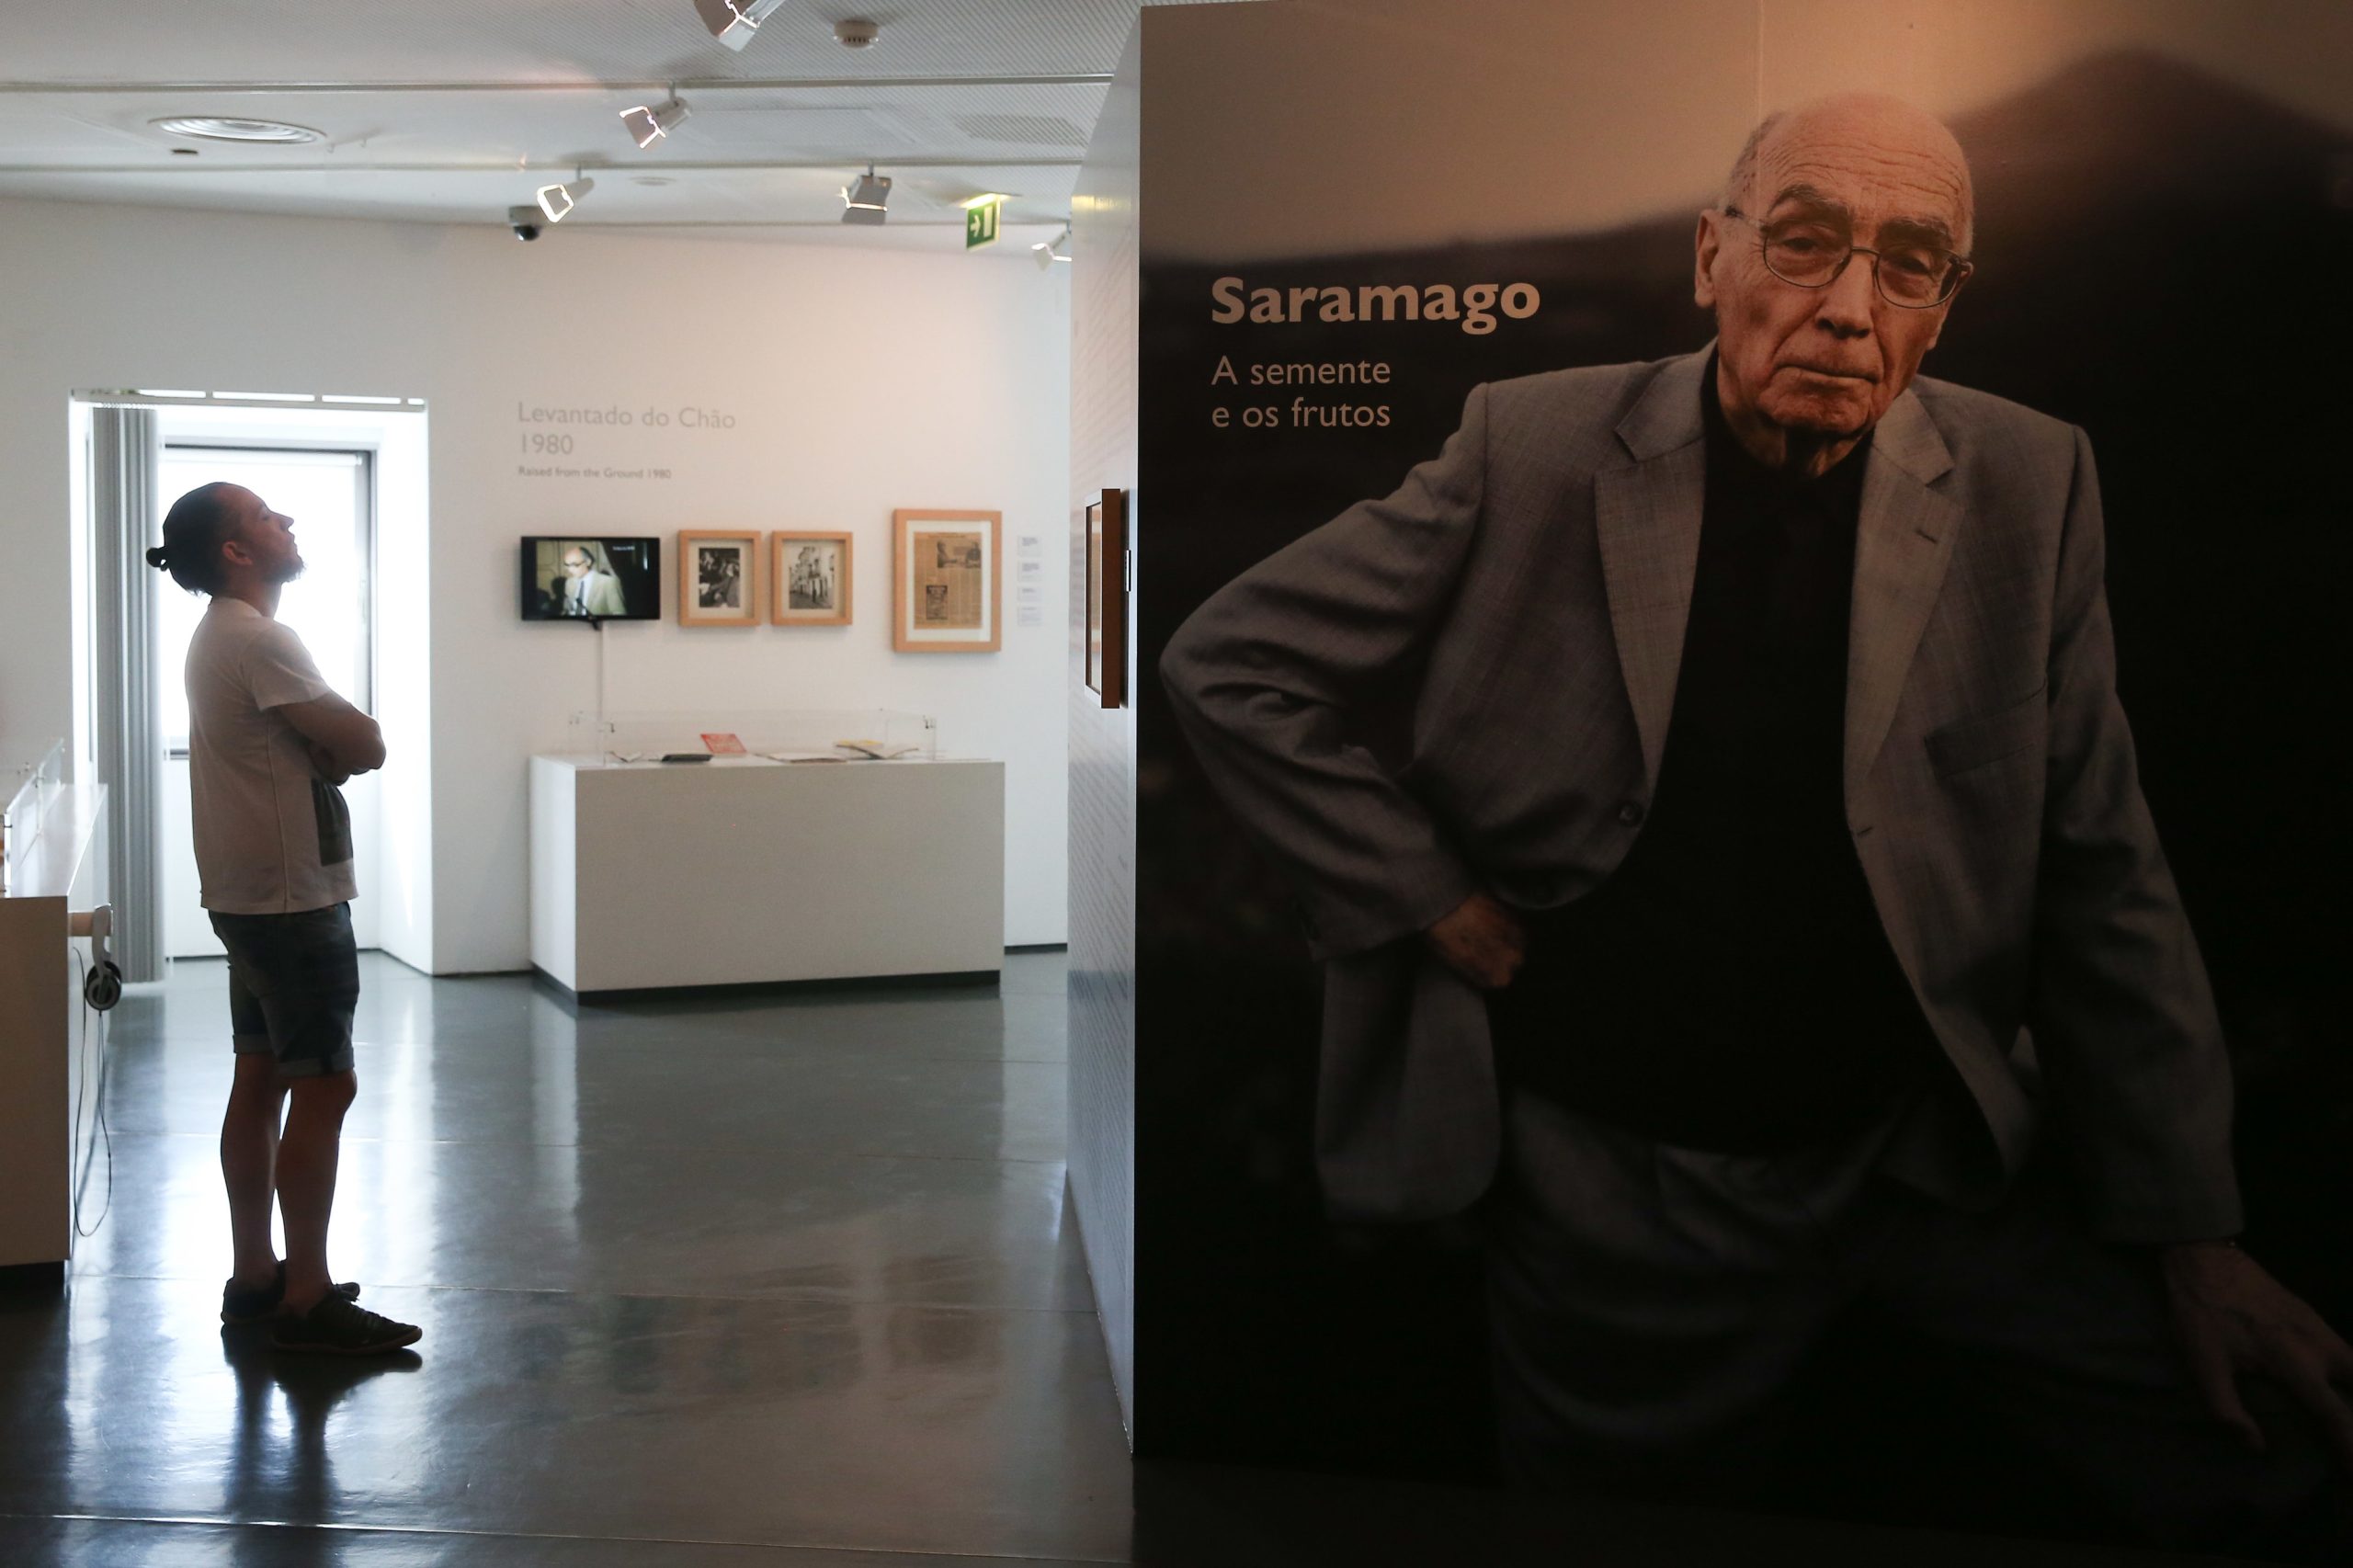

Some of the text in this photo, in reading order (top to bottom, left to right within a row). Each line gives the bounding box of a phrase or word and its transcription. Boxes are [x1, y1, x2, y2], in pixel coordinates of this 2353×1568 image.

[1211, 277, 1540, 335] Saramago
[1211, 356, 1391, 385] A semente
[517, 402, 736, 428] Levantado do Chão
[1211, 397, 1391, 427] e os frutos
[521, 433, 574, 455] 1980
[518, 466, 672, 480] Raised from the Ground 1980
